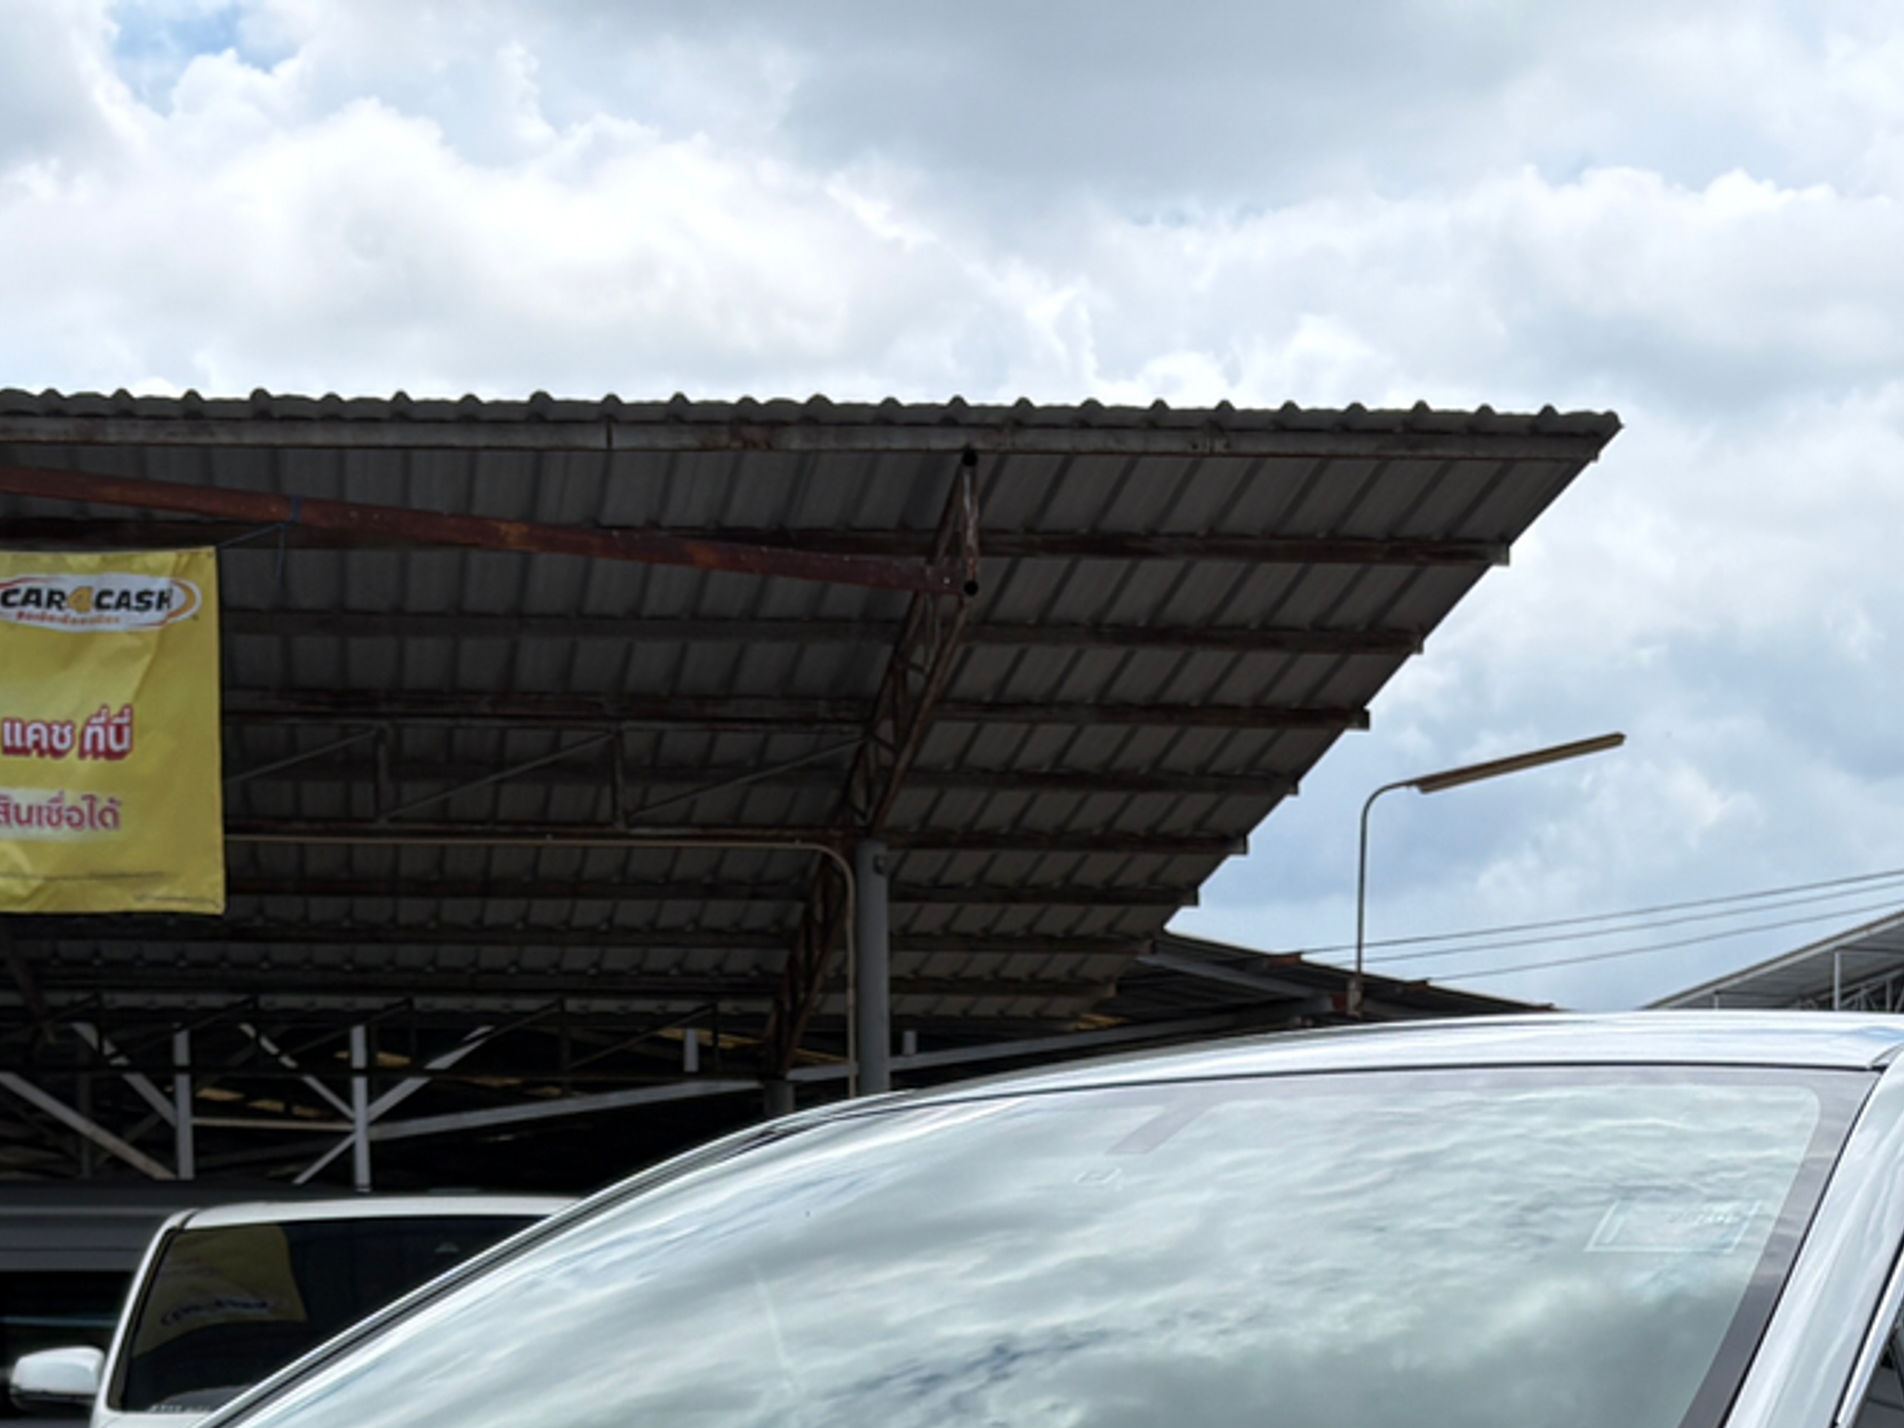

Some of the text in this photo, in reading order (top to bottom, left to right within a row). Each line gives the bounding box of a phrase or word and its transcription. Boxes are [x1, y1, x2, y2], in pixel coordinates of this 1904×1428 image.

[0, 585, 173, 614] CAR4CASH
[3, 720, 72, 753] แคช
[83, 708, 132, 755] ที่นี่
